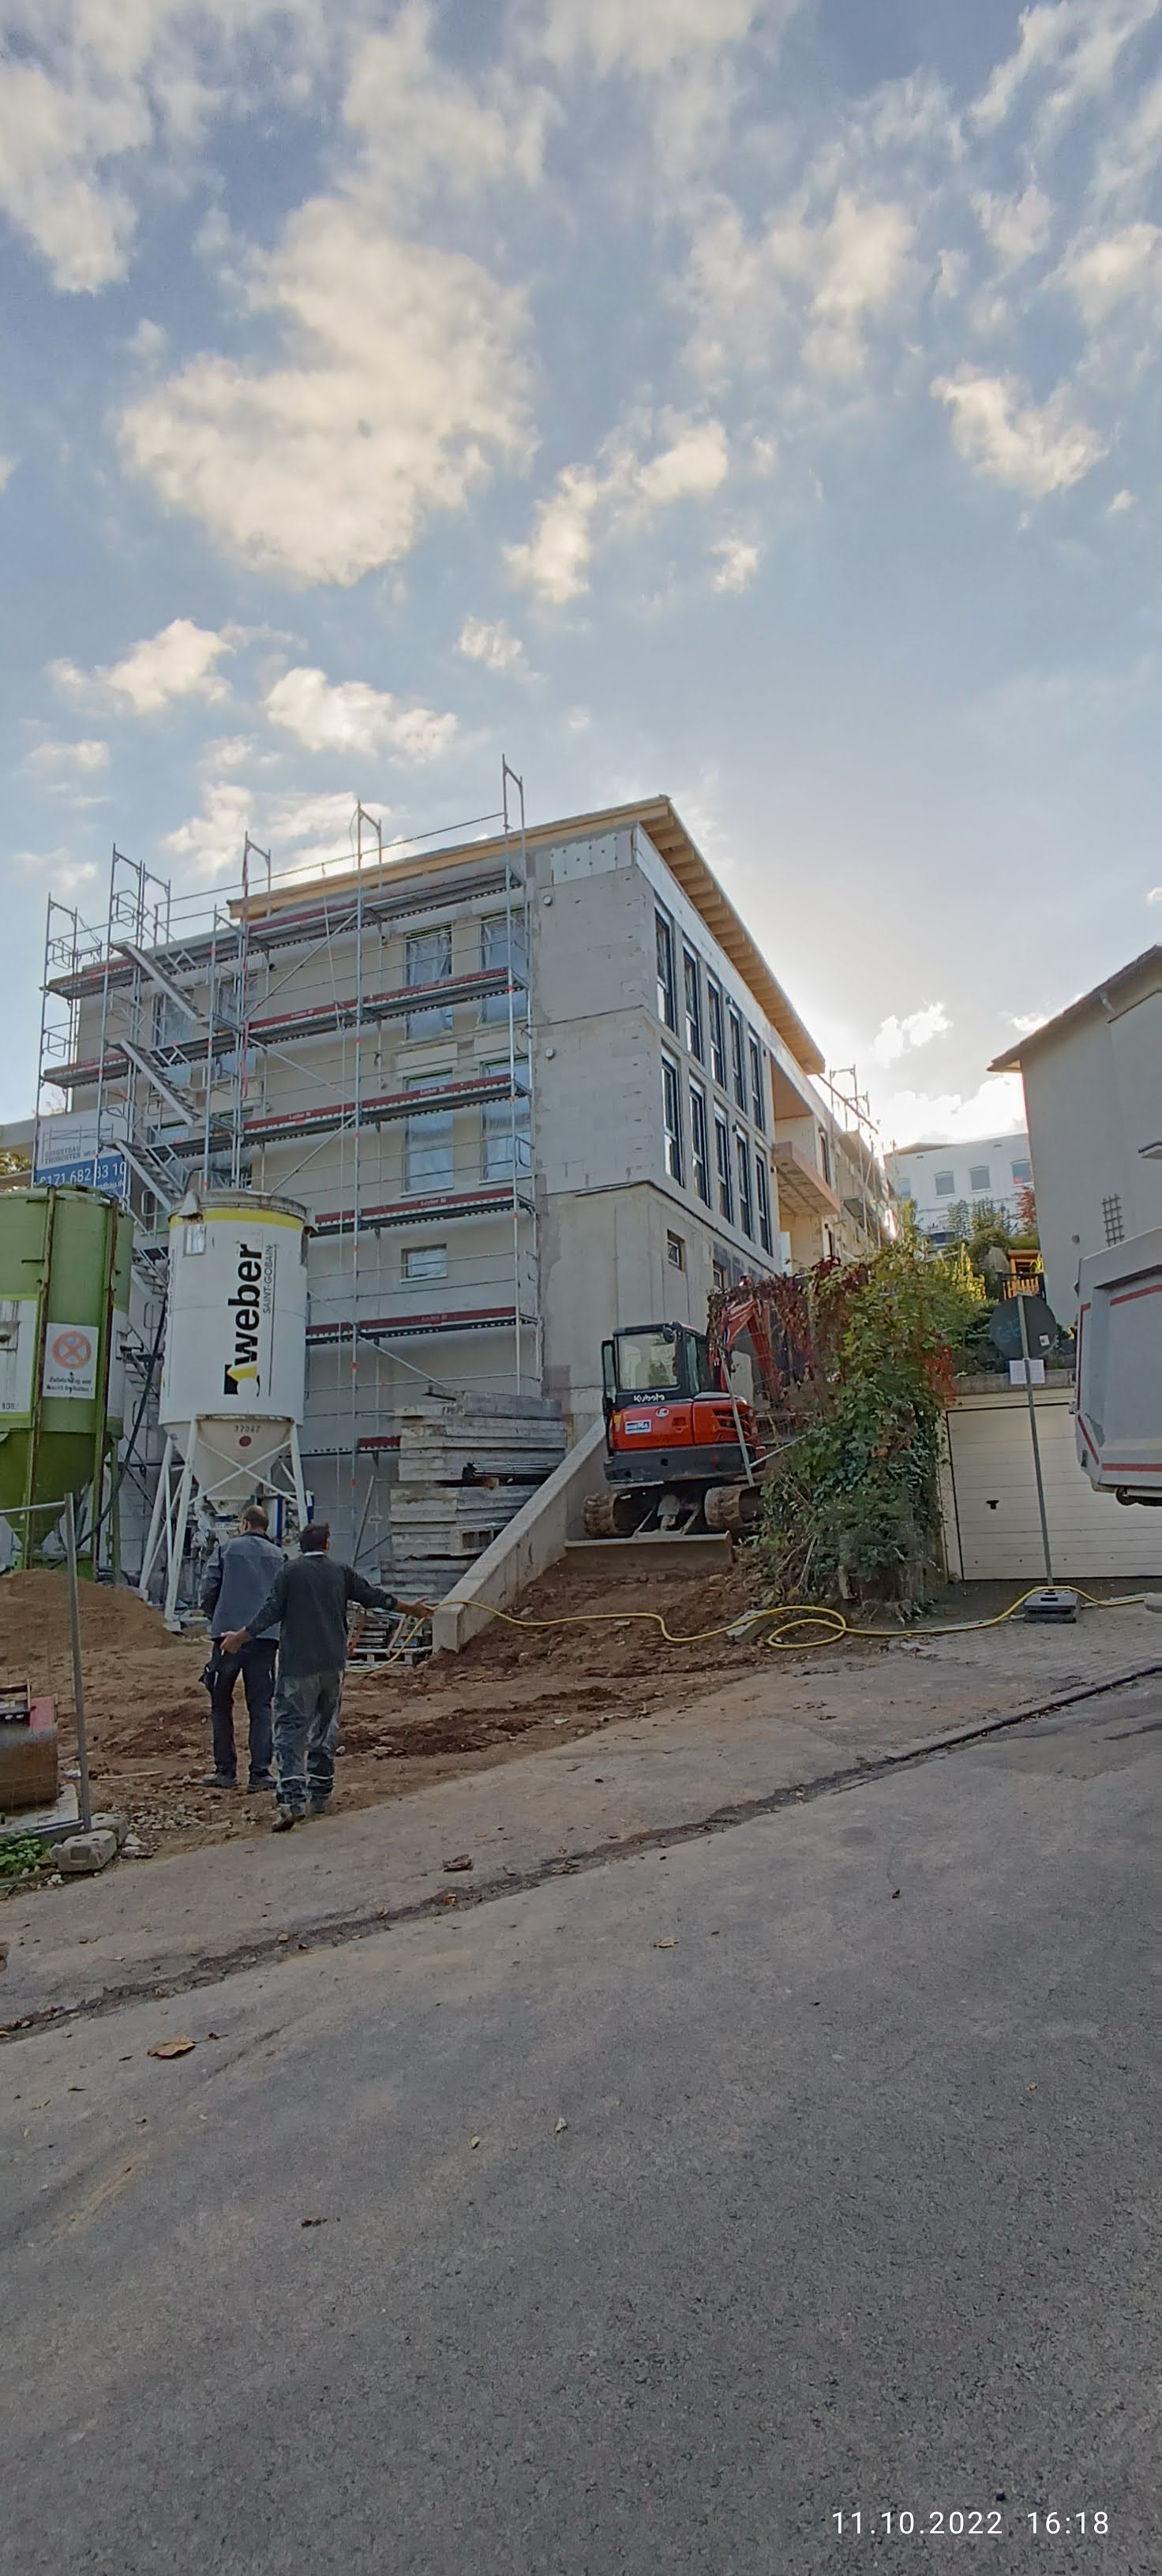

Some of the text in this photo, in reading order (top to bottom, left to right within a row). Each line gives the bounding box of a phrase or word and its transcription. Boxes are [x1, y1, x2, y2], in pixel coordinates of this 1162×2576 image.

[69, 1168, 92, 1183] 682
[263, 1244, 275, 1314] SAINT-GOBAIN
[228, 1244, 262, 1366] weber
[633, 1393, 665, 1402] Kubota
